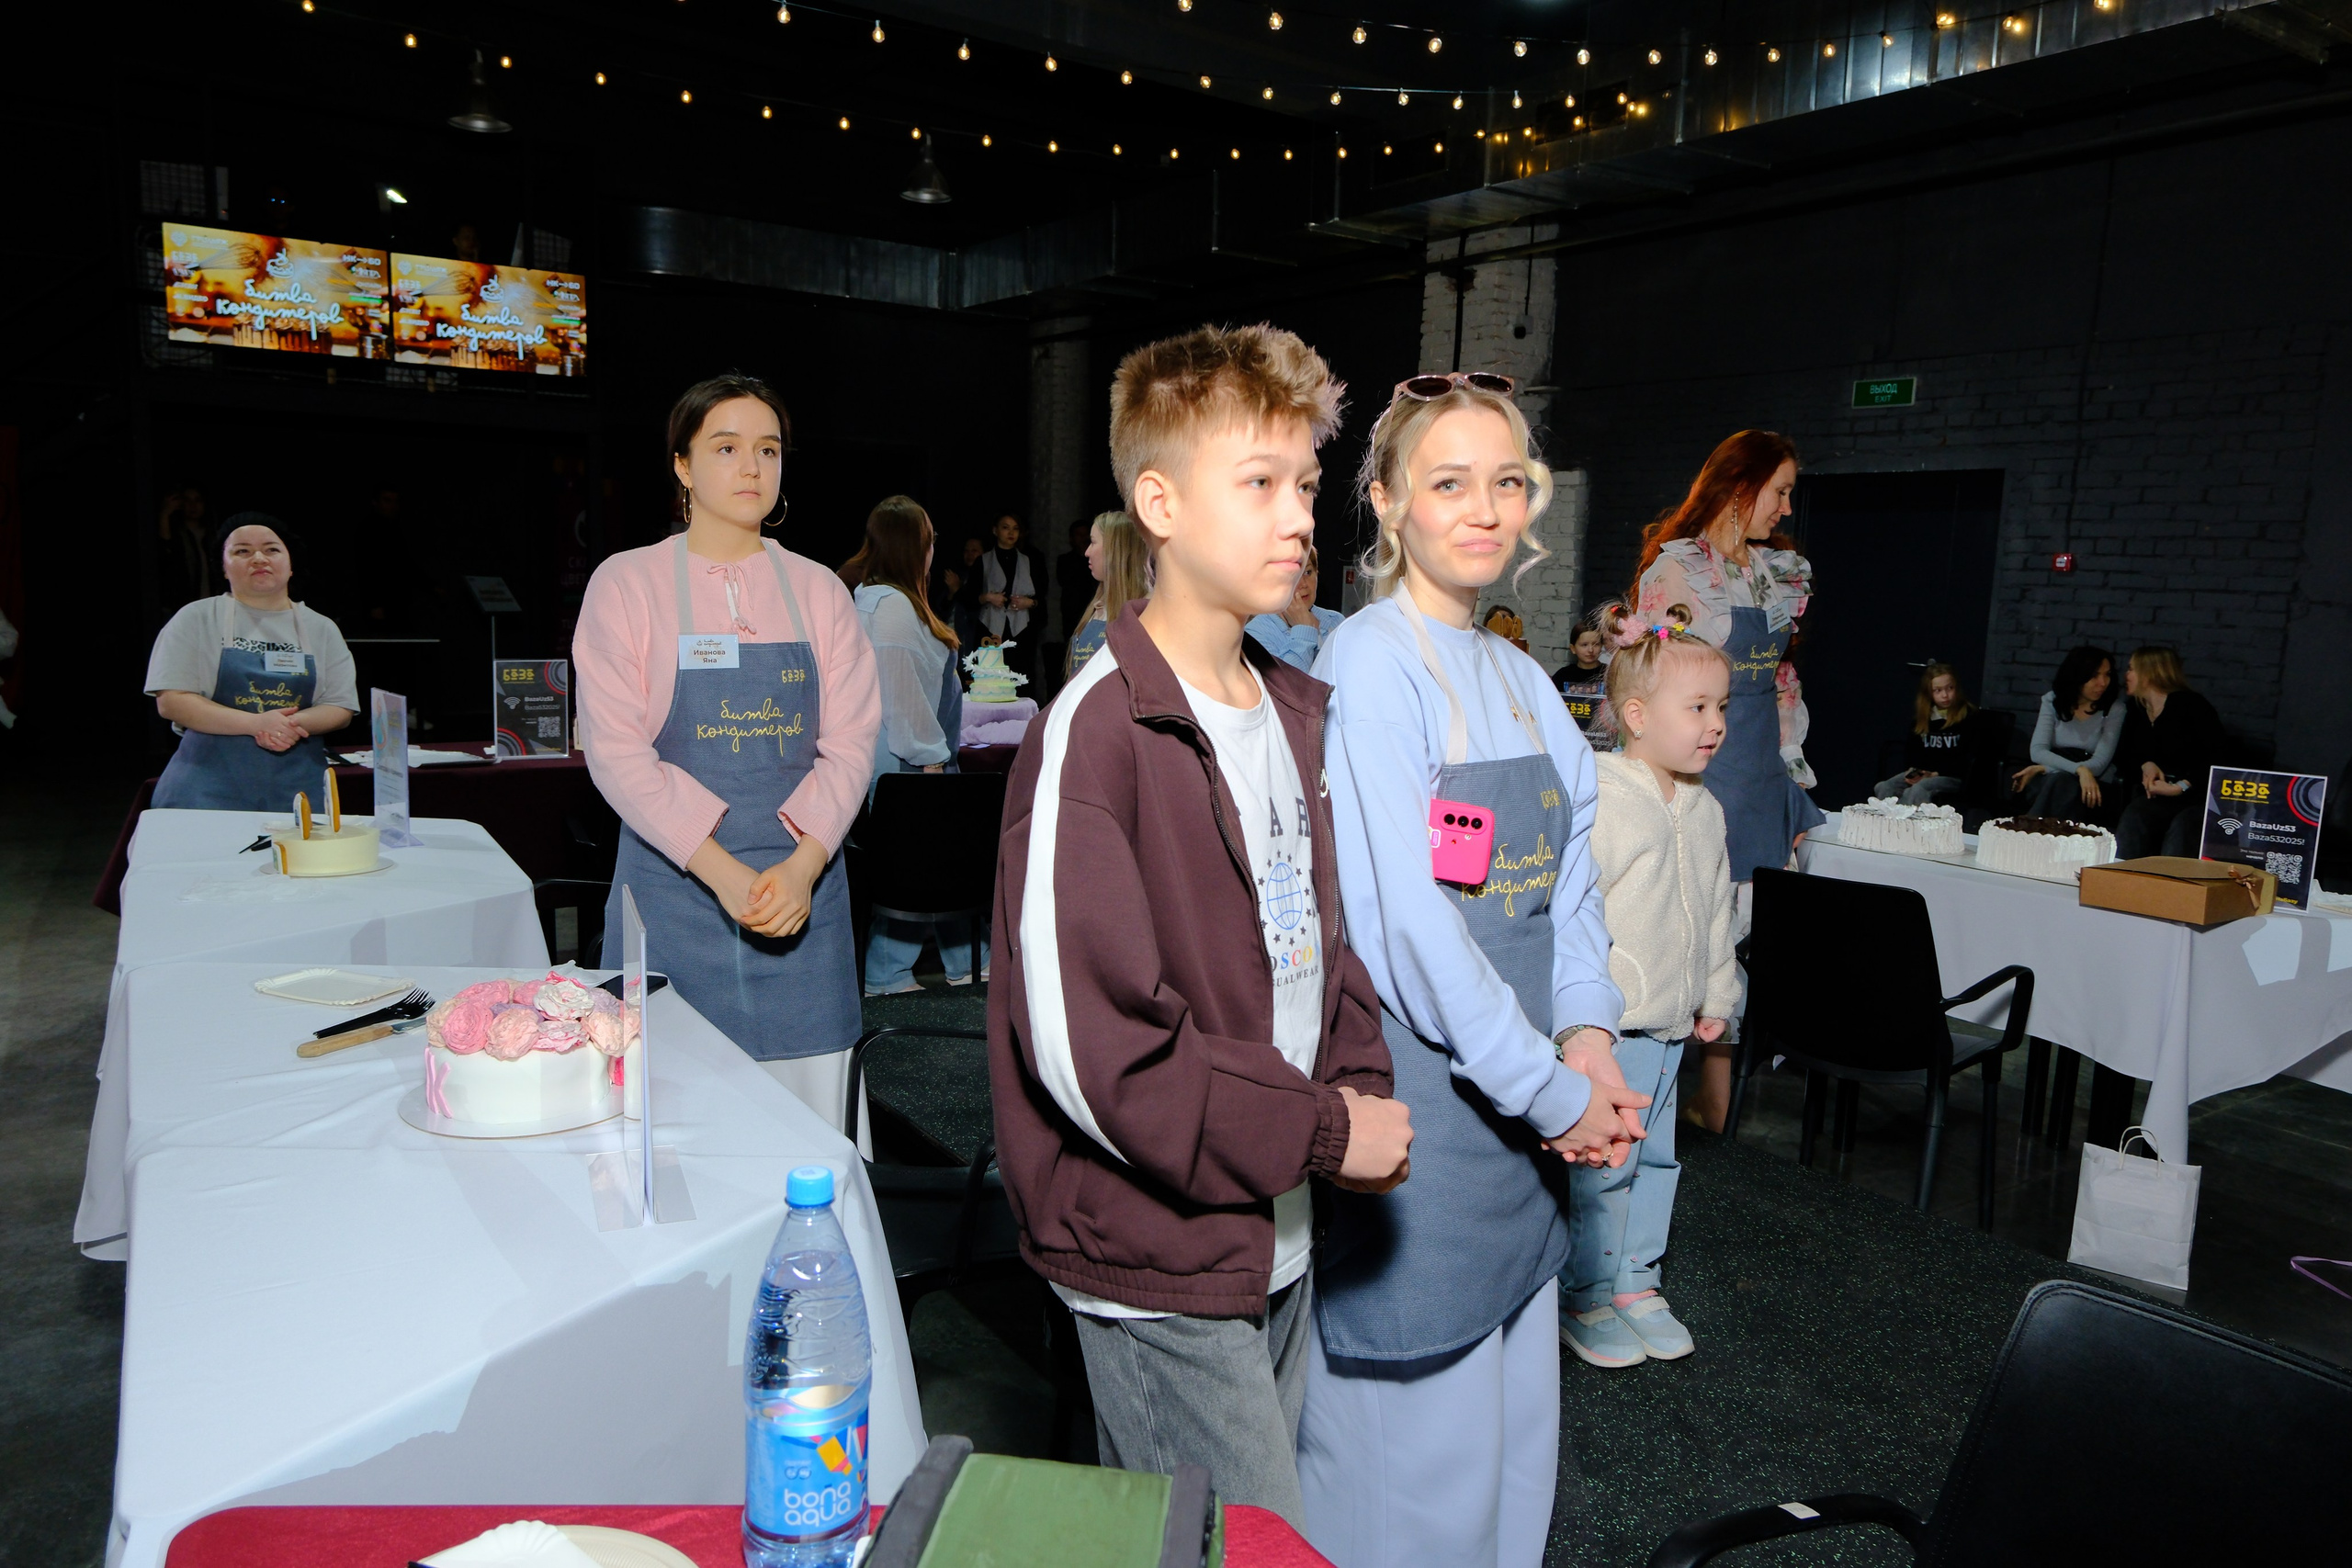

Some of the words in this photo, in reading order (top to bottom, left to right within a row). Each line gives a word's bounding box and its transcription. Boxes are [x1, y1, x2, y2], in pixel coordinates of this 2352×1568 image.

[244, 278, 317, 303] битва
[461, 303, 524, 326] битва
[1870, 383, 1898, 394] ВЫХОД
[1874, 395, 1892, 403] EXIT
[720, 697, 785, 721] битва
[696, 713, 804, 757] кондитеров
[2249, 820, 2297, 833] BazaUz53
[2247, 832, 2305, 846] Baza532025!
[1495, 833, 1555, 870] битва
